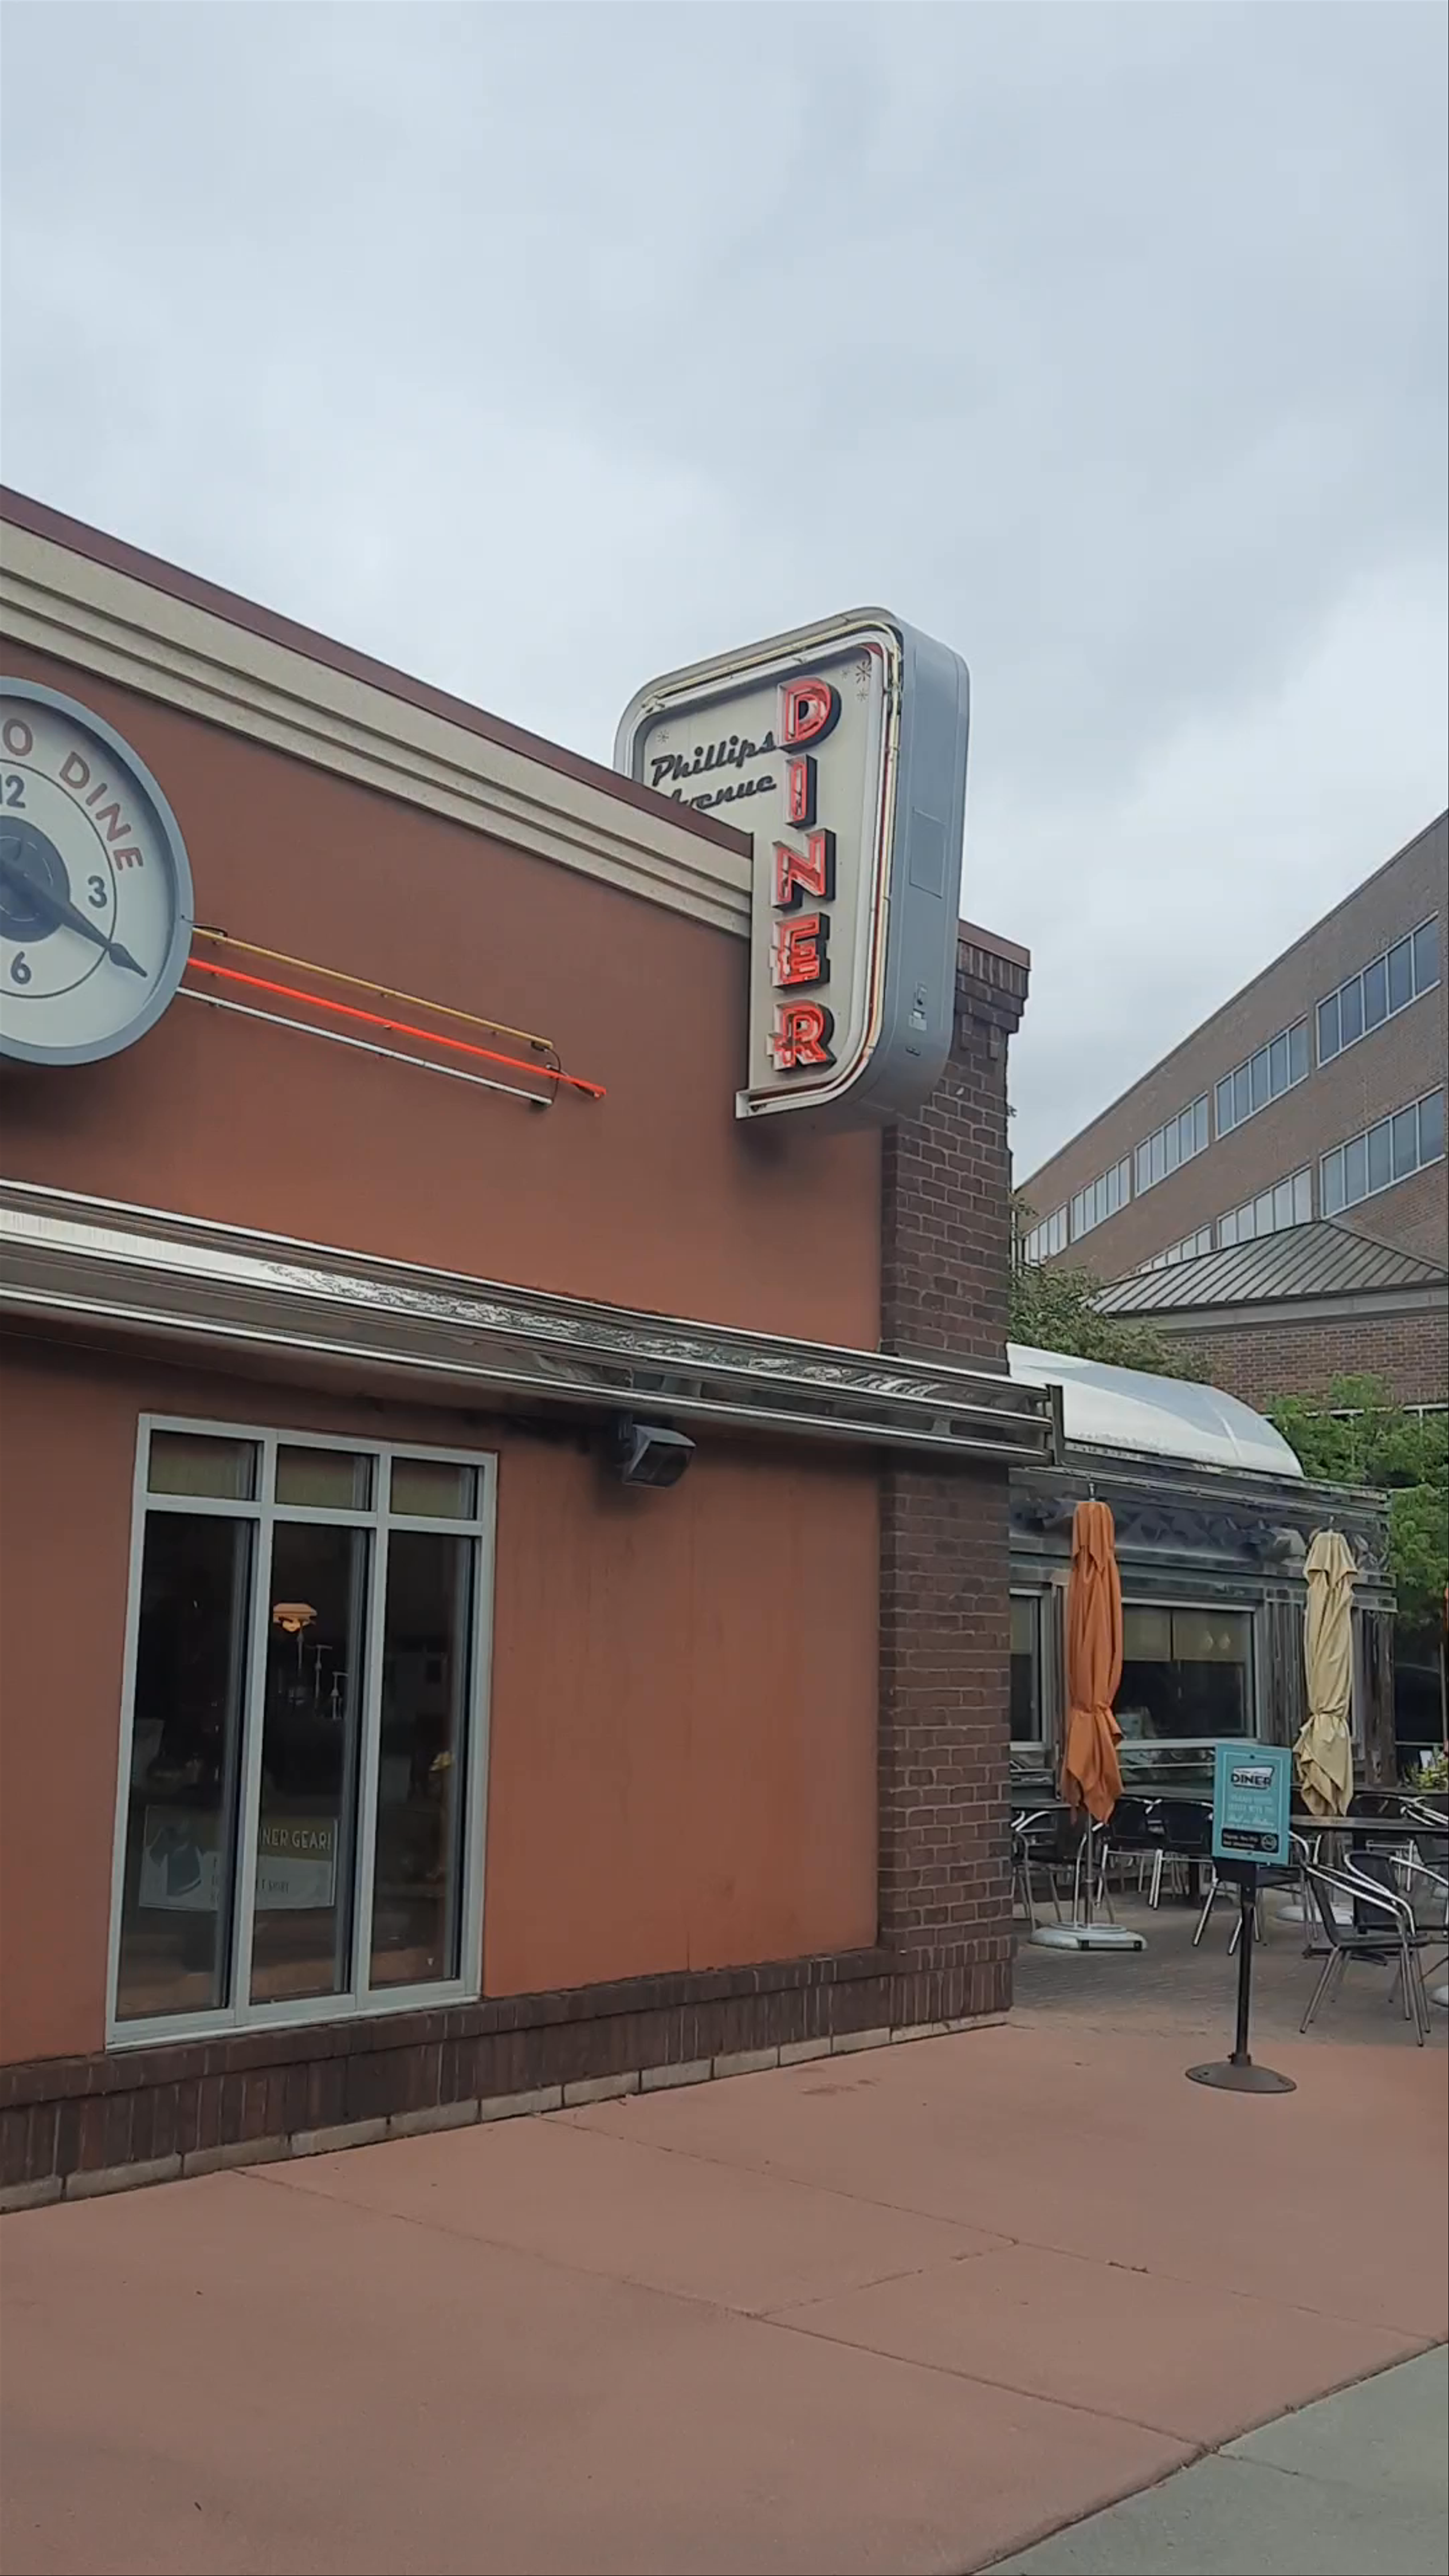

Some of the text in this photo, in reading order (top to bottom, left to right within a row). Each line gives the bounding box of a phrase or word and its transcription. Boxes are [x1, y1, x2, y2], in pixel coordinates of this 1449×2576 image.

[651, 731, 779, 786] Phillips
[3, 718, 143, 871] O DINE
[88, 875, 107, 907] 3
[767, 677, 841, 1072] DINER
[11, 951, 31, 984] 6
[1231, 1773, 1272, 1787] DINER
[260, 1827, 331, 1851] INER GEAR!
